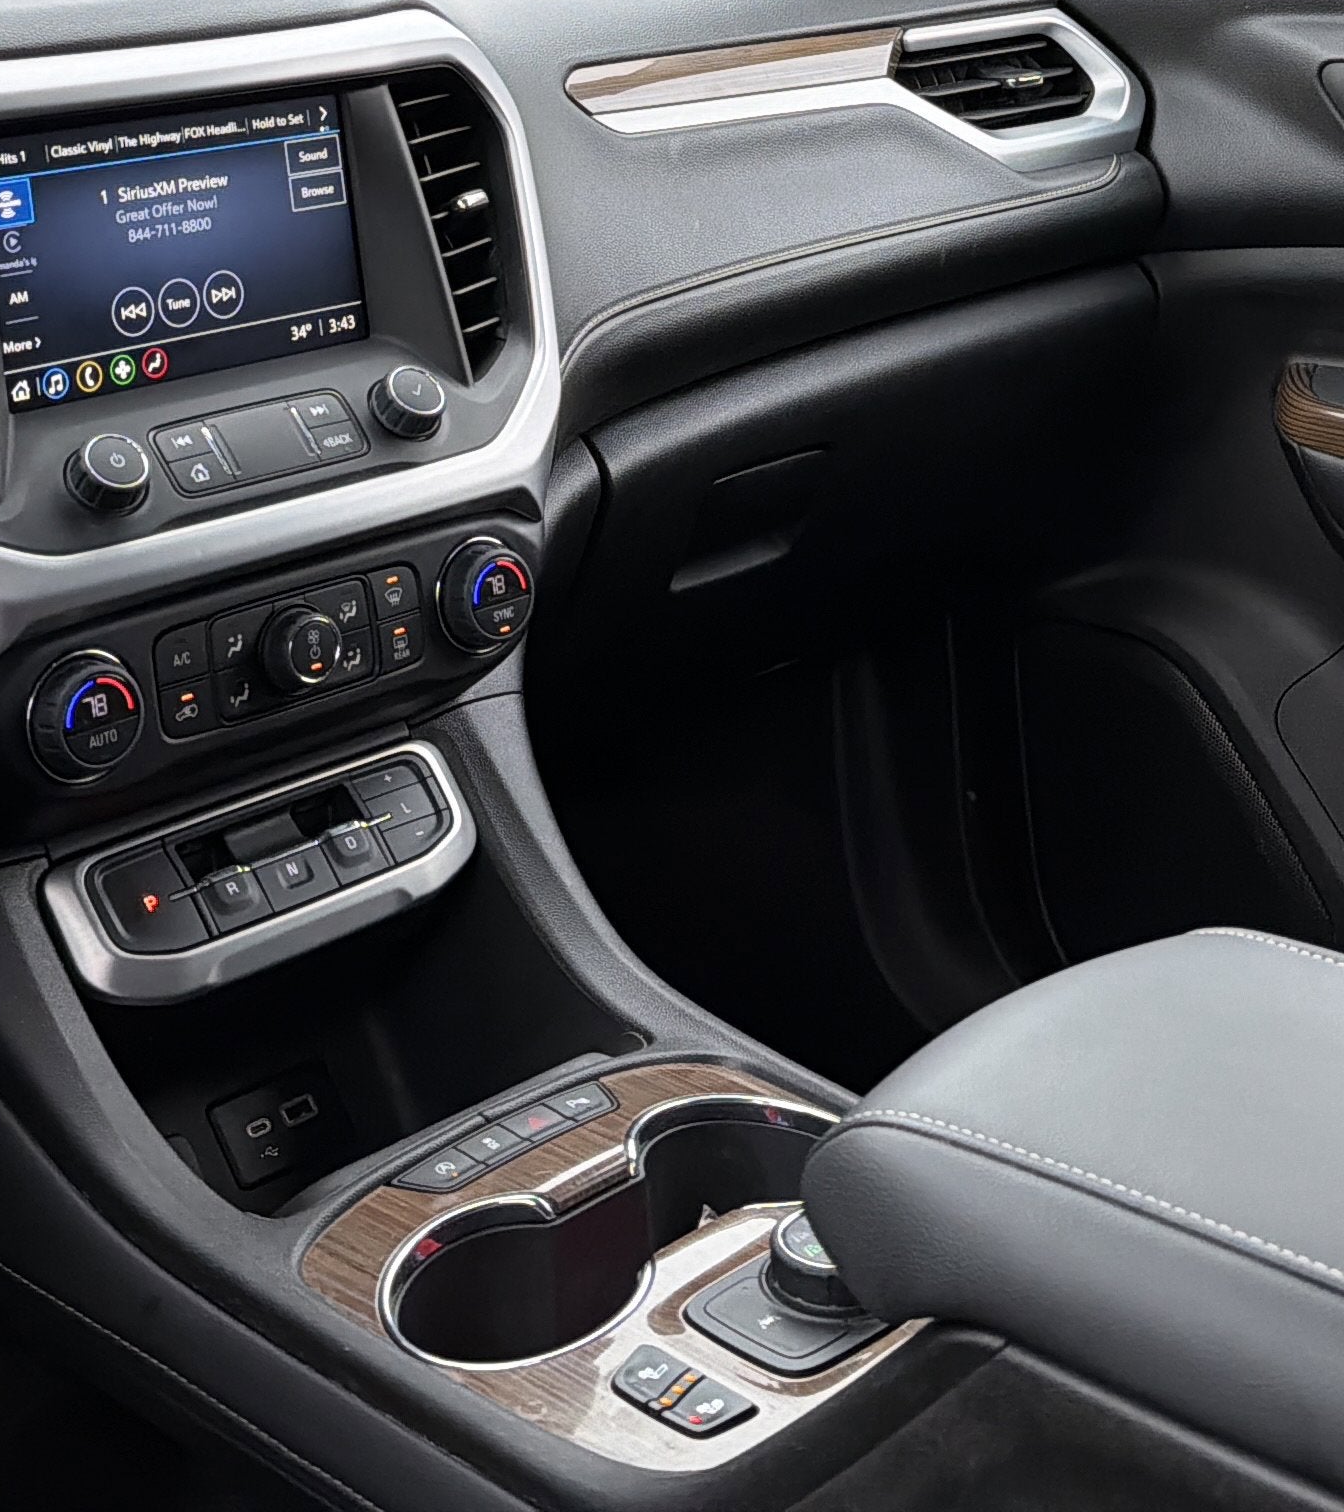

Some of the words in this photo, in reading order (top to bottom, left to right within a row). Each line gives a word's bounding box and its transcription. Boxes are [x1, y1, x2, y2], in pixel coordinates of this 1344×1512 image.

[252, 116, 275, 130] Hold
[276, 116, 287, 126] to
[287, 113, 304, 125] Set
[118, 136, 138, 149] The
[138, 131, 182, 147] Highway
[184, 126, 205, 139] FOX
[50, 143, 87, 158] Classic
[87, 138, 113, 155] Vinyl
[298, 148, 329, 163] Sound
[100, 189, 108, 205] 1
[117, 179, 176, 203] SiriusXM
[178, 175, 229, 193] Preview
[301, 185, 335, 199] Browse
[115, 208, 150, 224] Great
[151, 201, 184, 218] Offer
[128, 216, 212, 243] 844-711-8800
[9, 290, 29, 305] AM
[166, 297, 191, 311] Tune
[328, 314, 357, 334] 3:43
[2, 341, 33, 355] More
[485, 574, 506, 595] 78
[493, 606, 515, 623] SYNC
[173, 651, 191, 667] A/C
[81, 693, 109, 718] 78
[89, 728, 118, 749] AUTO
[285, 861, 300, 877] N
[225, 881, 240, 896] R
[143, 894, 159, 913] P
